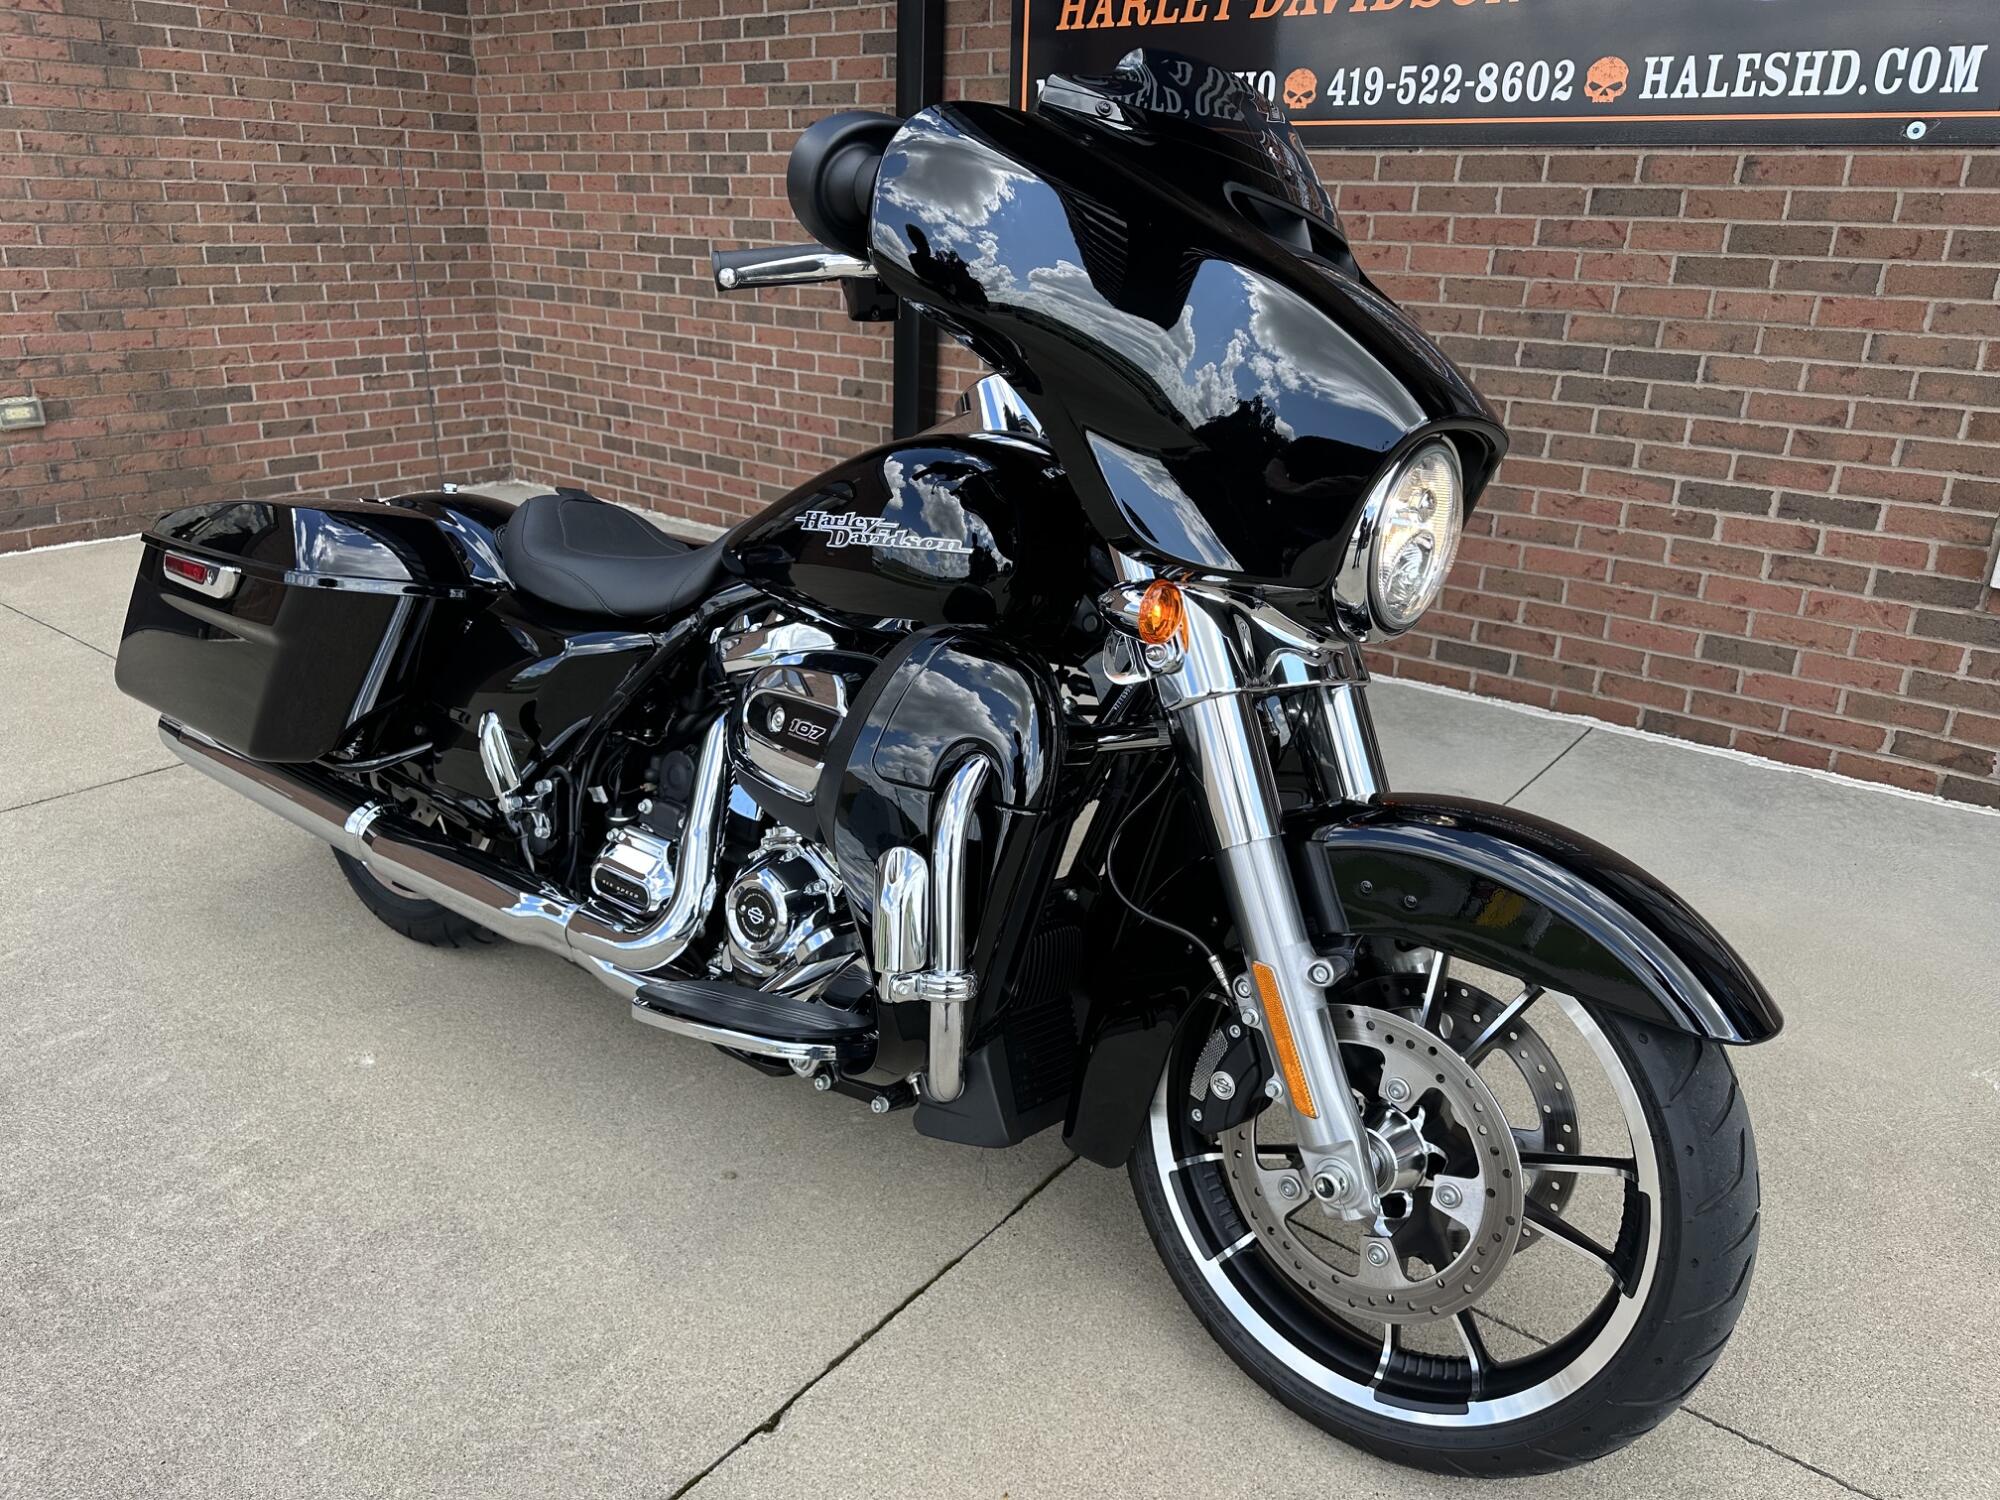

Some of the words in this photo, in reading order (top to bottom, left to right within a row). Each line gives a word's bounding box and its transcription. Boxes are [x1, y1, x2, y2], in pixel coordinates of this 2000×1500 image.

[1327, 59, 1575, 106] 419-522-8602
[1638, 44, 1988, 99] HALESHD.COM
[789, 718, 827, 741] 107
